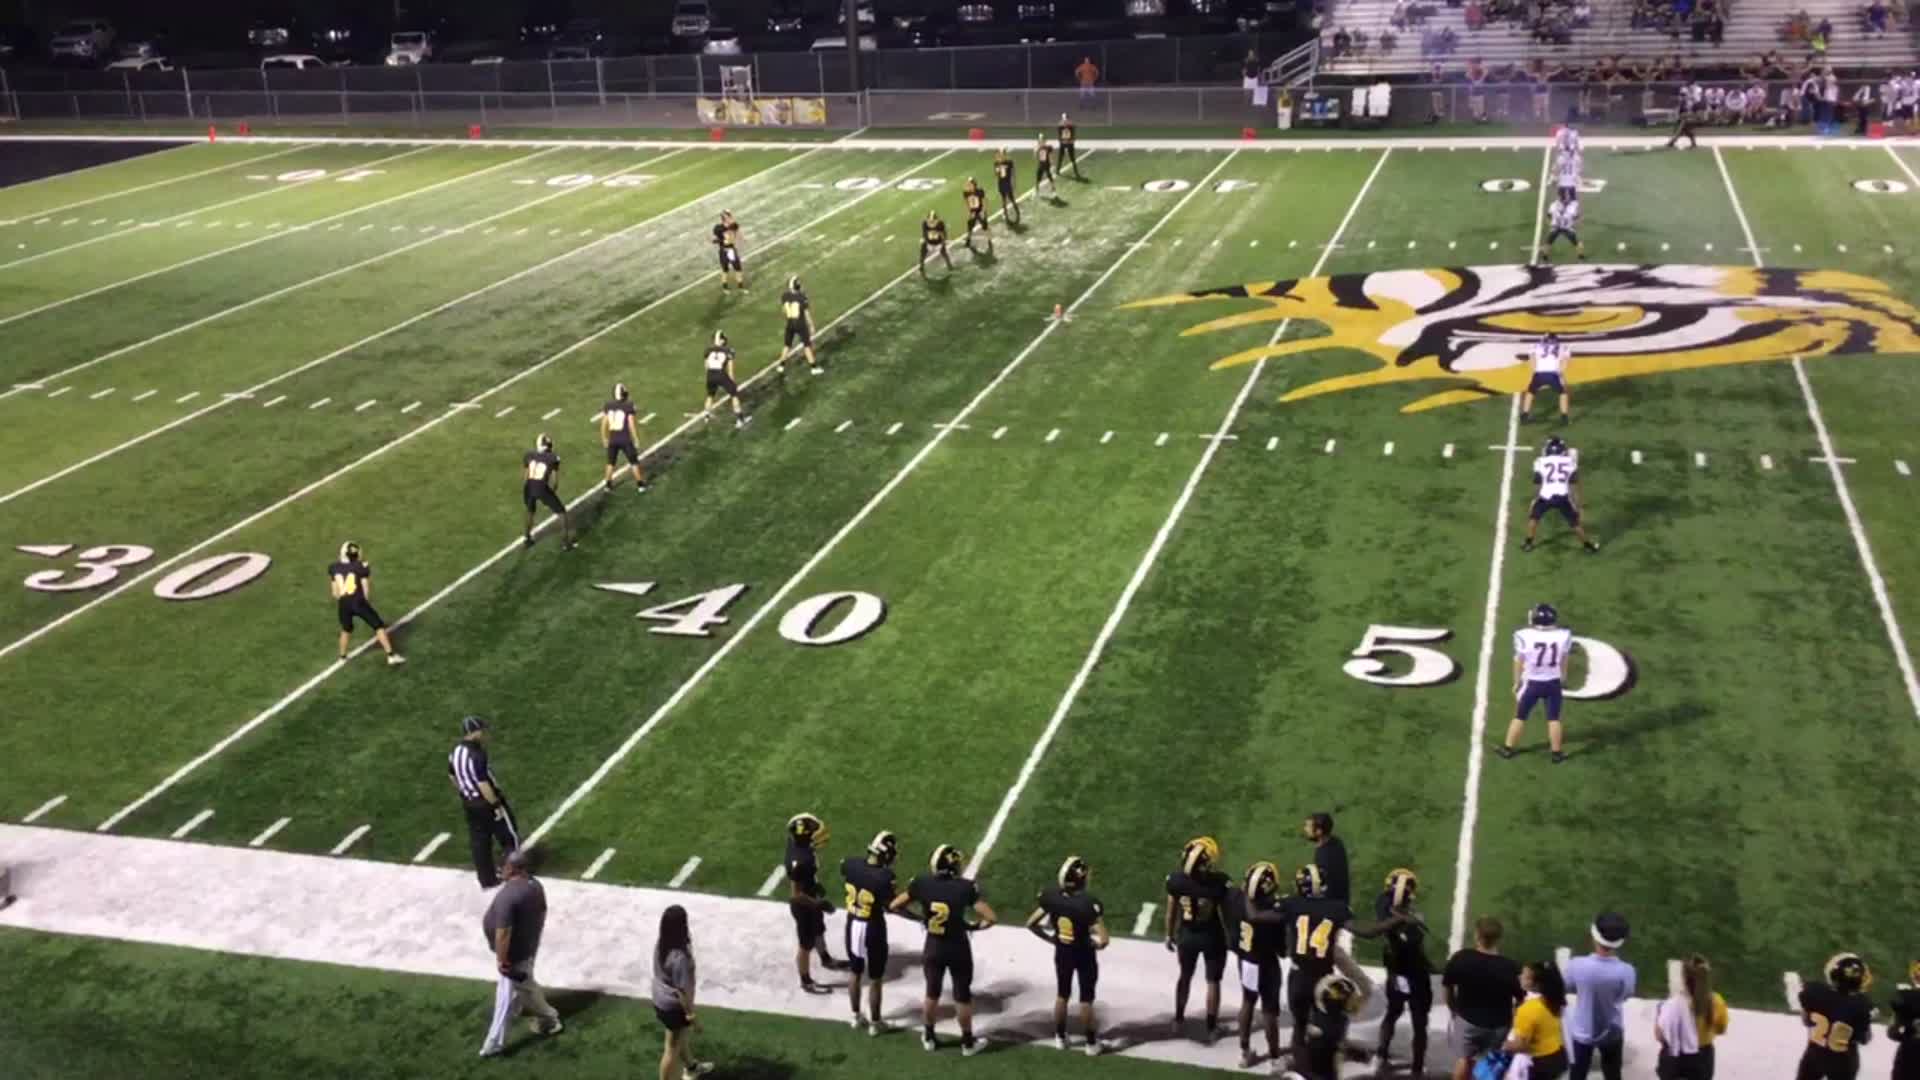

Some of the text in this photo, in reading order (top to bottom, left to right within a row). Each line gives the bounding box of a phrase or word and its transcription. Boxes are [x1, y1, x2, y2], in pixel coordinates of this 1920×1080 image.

[1541, 344, 1562, 358] 34
[1543, 462, 1568, 484] 25
[22, 543, 272, 600] 30
[635, 582, 886, 645] 40
[1533, 642, 1558, 667] 71
[929, 902, 949, 934] 2
[1294, 914, 1332, 959] 14
